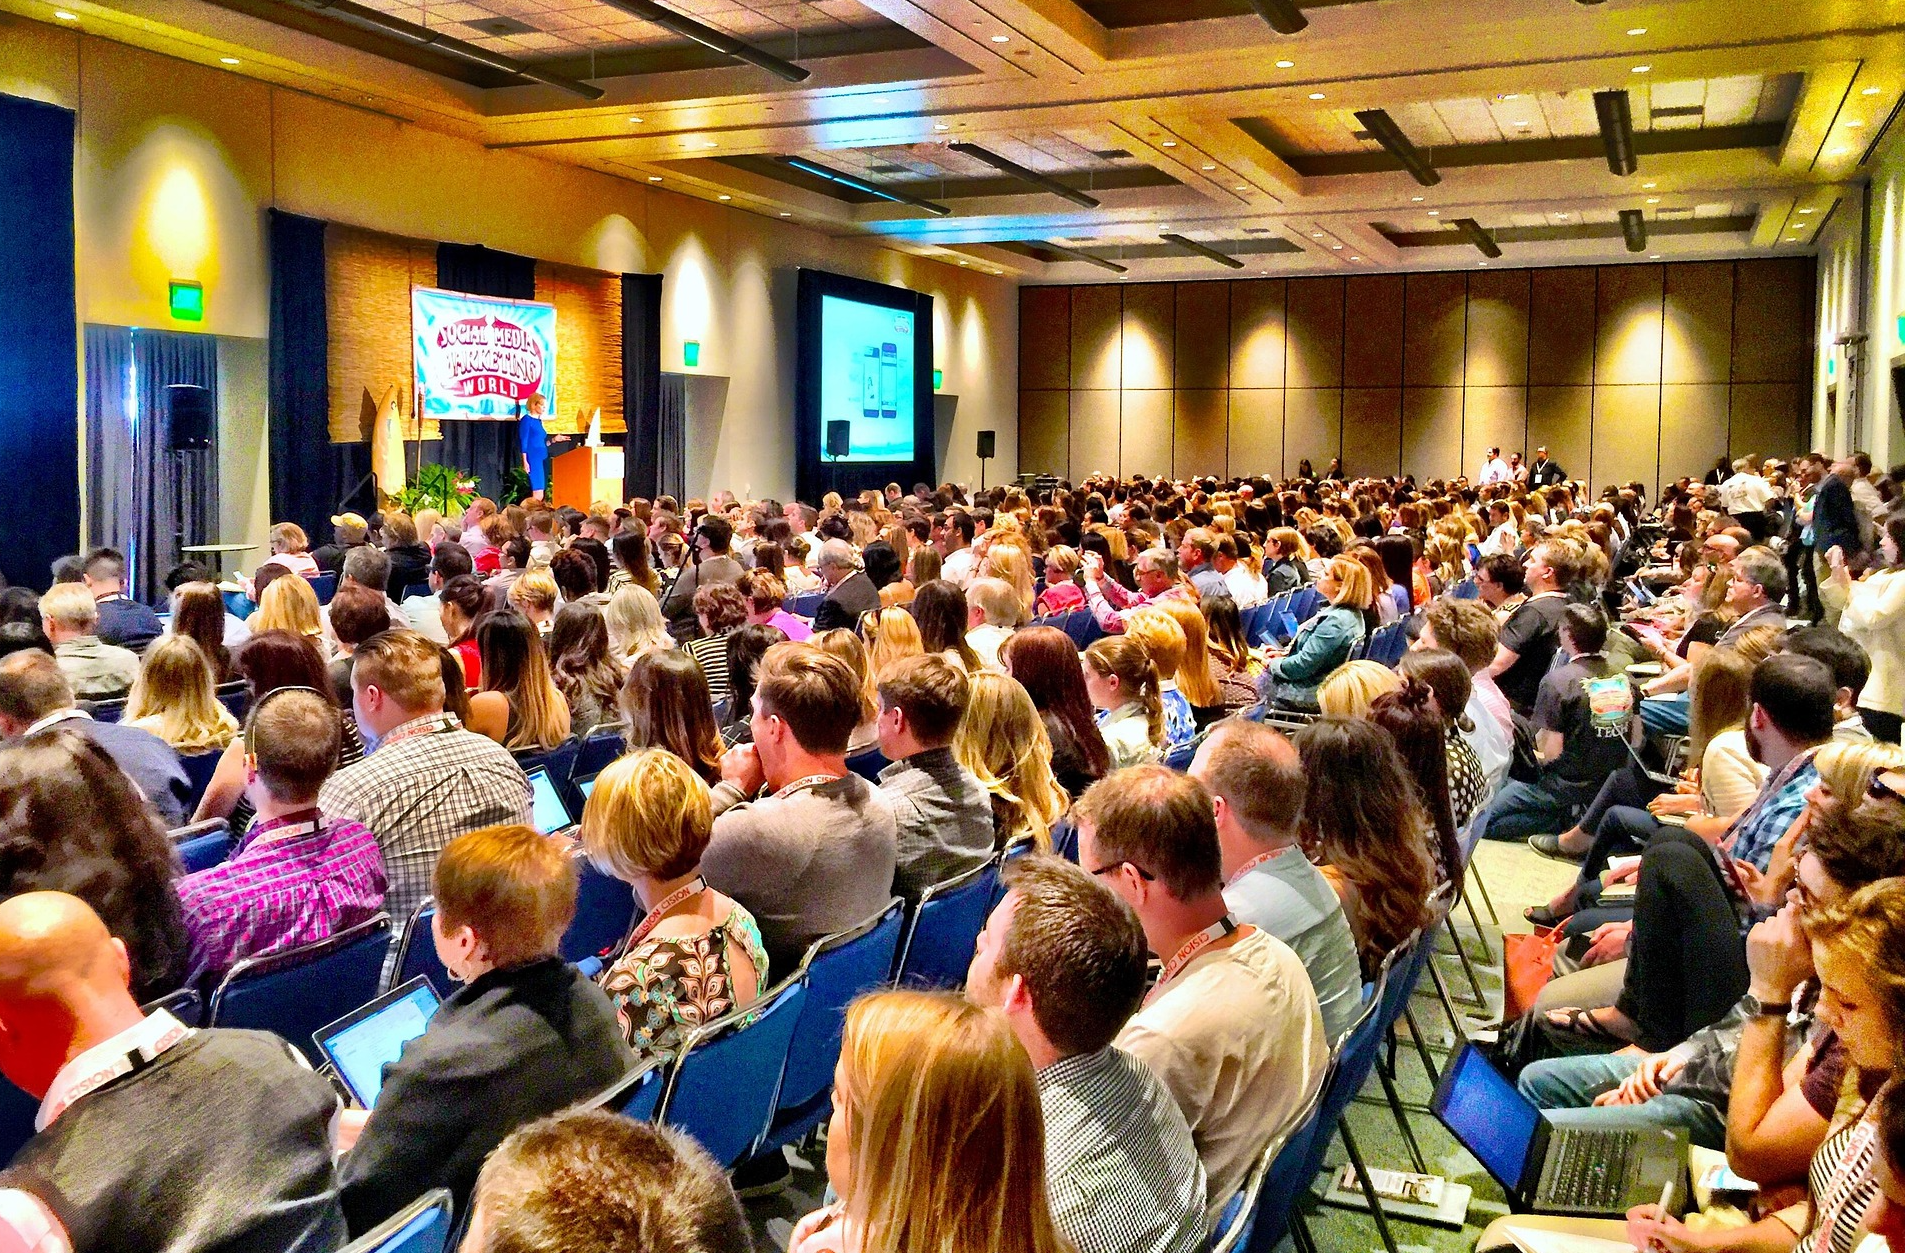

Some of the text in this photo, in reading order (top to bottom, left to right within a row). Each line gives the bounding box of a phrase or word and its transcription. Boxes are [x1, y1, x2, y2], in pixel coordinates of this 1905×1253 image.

[438, 324, 537, 357] SOCIAL MEDIA
[462, 377, 518, 398] WORLD
[407, 724, 434, 736] CISION
[788, 777, 813, 791] CISION
[269, 825, 302, 840] CISION
[661, 887, 691, 909] CISION
[1177, 933, 1210, 961] CISION
[67, 1065, 117, 1101] CISION
[1842, 1126, 1869, 1166] CISION
